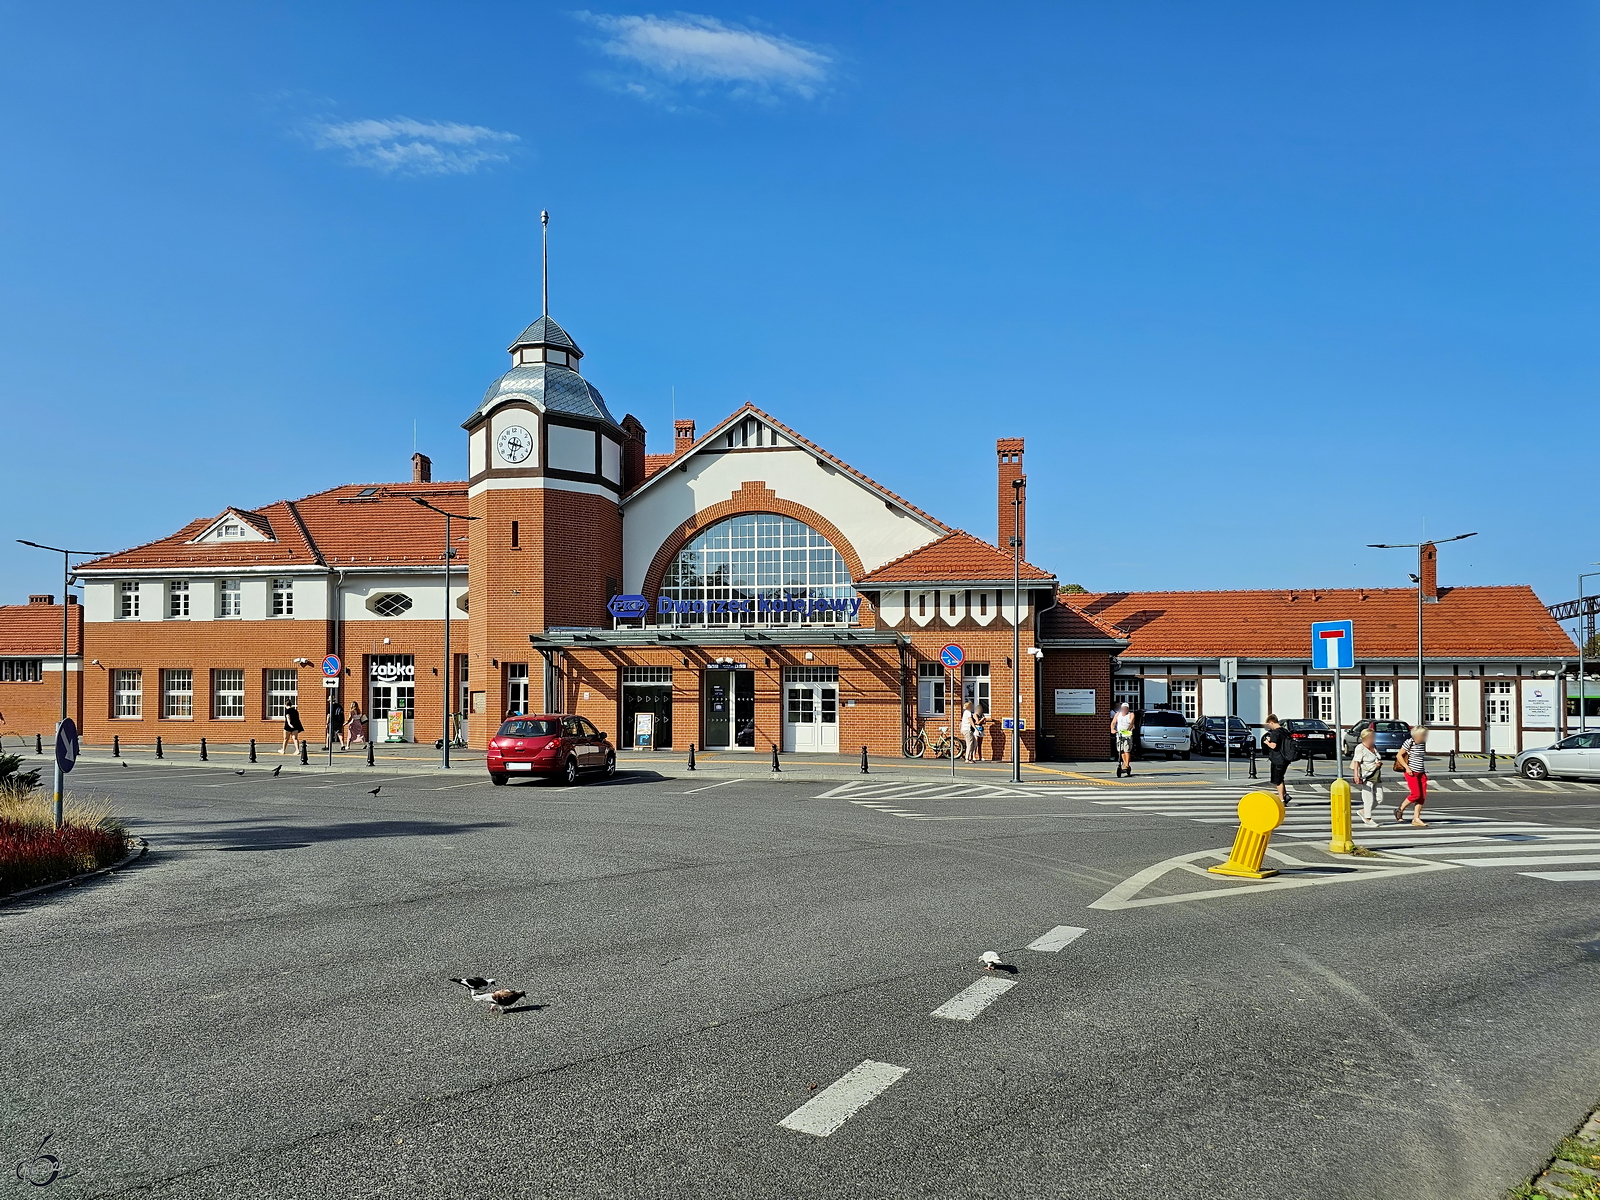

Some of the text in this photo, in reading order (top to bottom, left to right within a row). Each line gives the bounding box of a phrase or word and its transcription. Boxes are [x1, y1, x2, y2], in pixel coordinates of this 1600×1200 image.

[613, 601, 645, 612] PKP
[658, 594, 863, 617] Dworzec kolejowy
[370, 662, 414, 676] żabka
